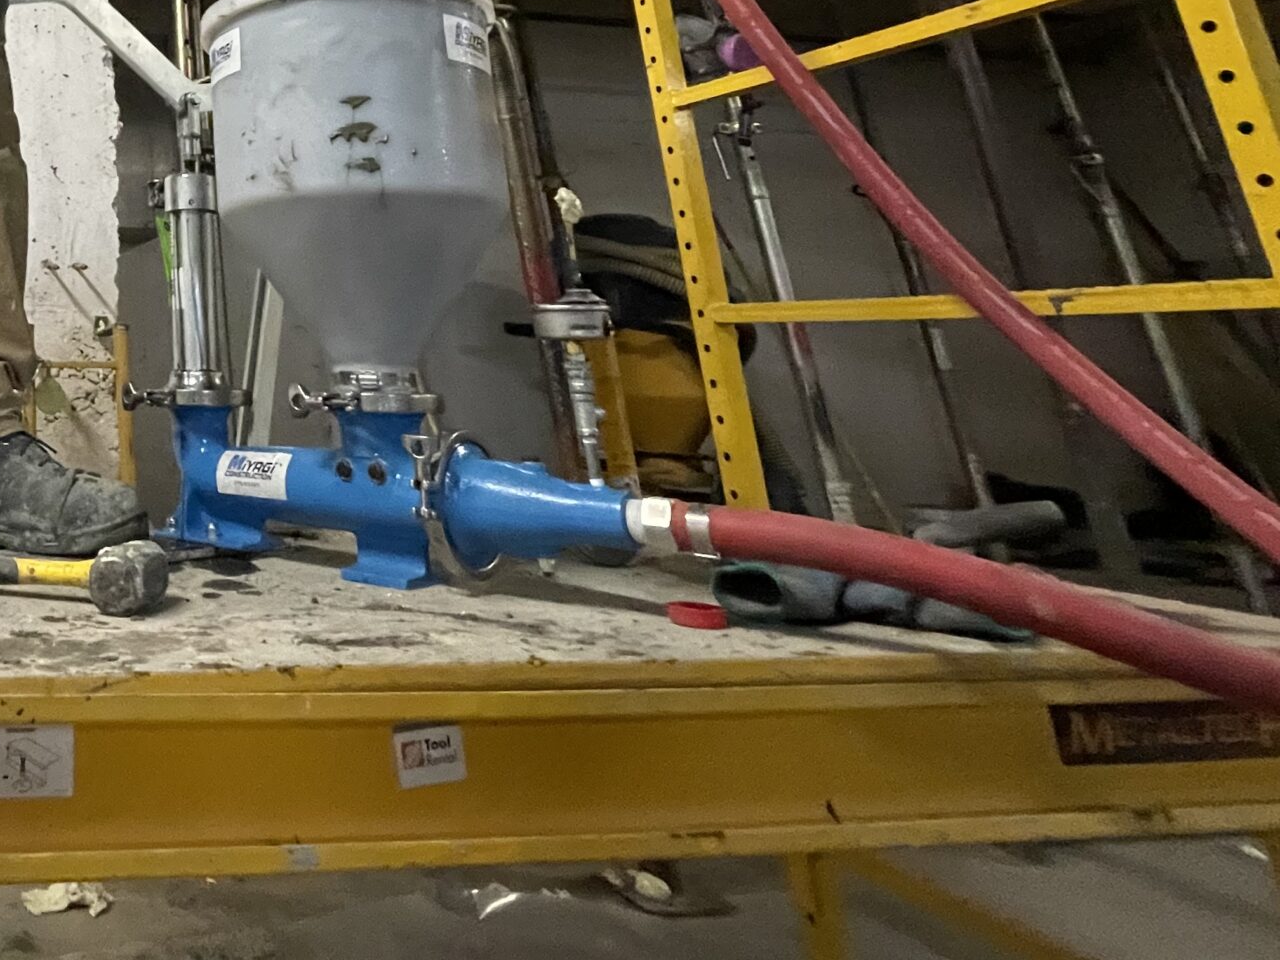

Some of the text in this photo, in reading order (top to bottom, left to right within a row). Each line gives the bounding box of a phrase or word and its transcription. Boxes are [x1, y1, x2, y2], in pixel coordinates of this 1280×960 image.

[224, 470, 273, 481] CONSTRUCTION
[424, 734, 452, 752] Tool
[426, 748, 458, 766] Rental
